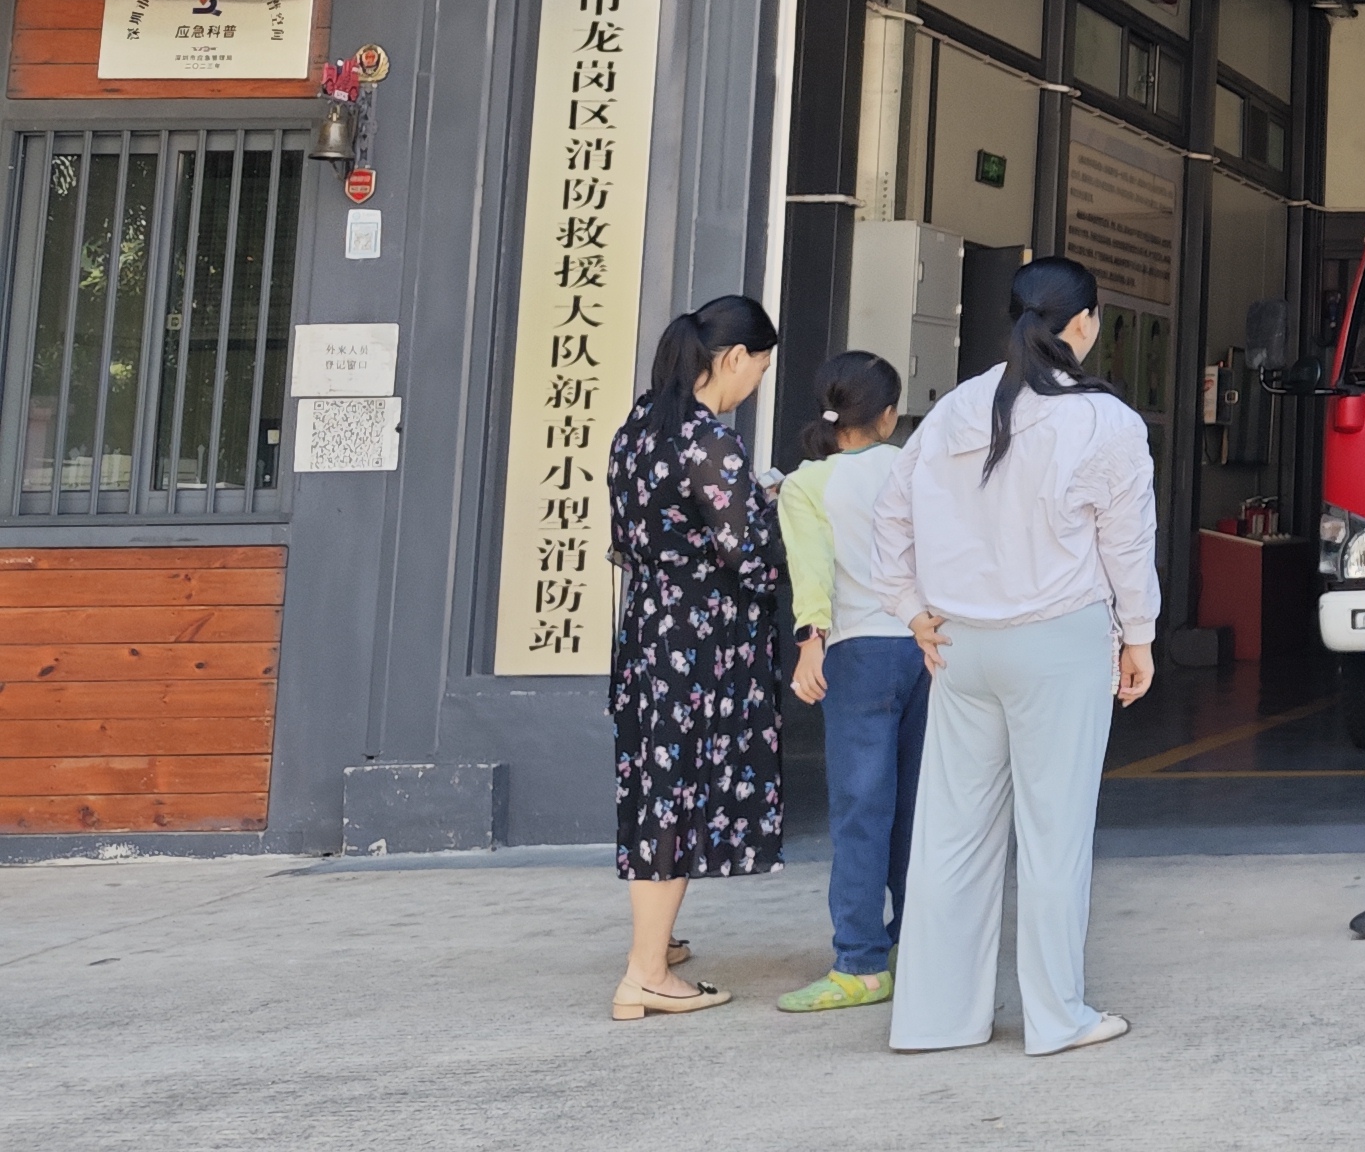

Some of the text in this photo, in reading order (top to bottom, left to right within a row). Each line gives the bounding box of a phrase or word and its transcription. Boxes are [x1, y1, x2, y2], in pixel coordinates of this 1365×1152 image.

[175, 25, 237, 39] 应急科普
[326, 344, 369, 355] 外来人员
[325, 360, 368, 371] 登记窗口
